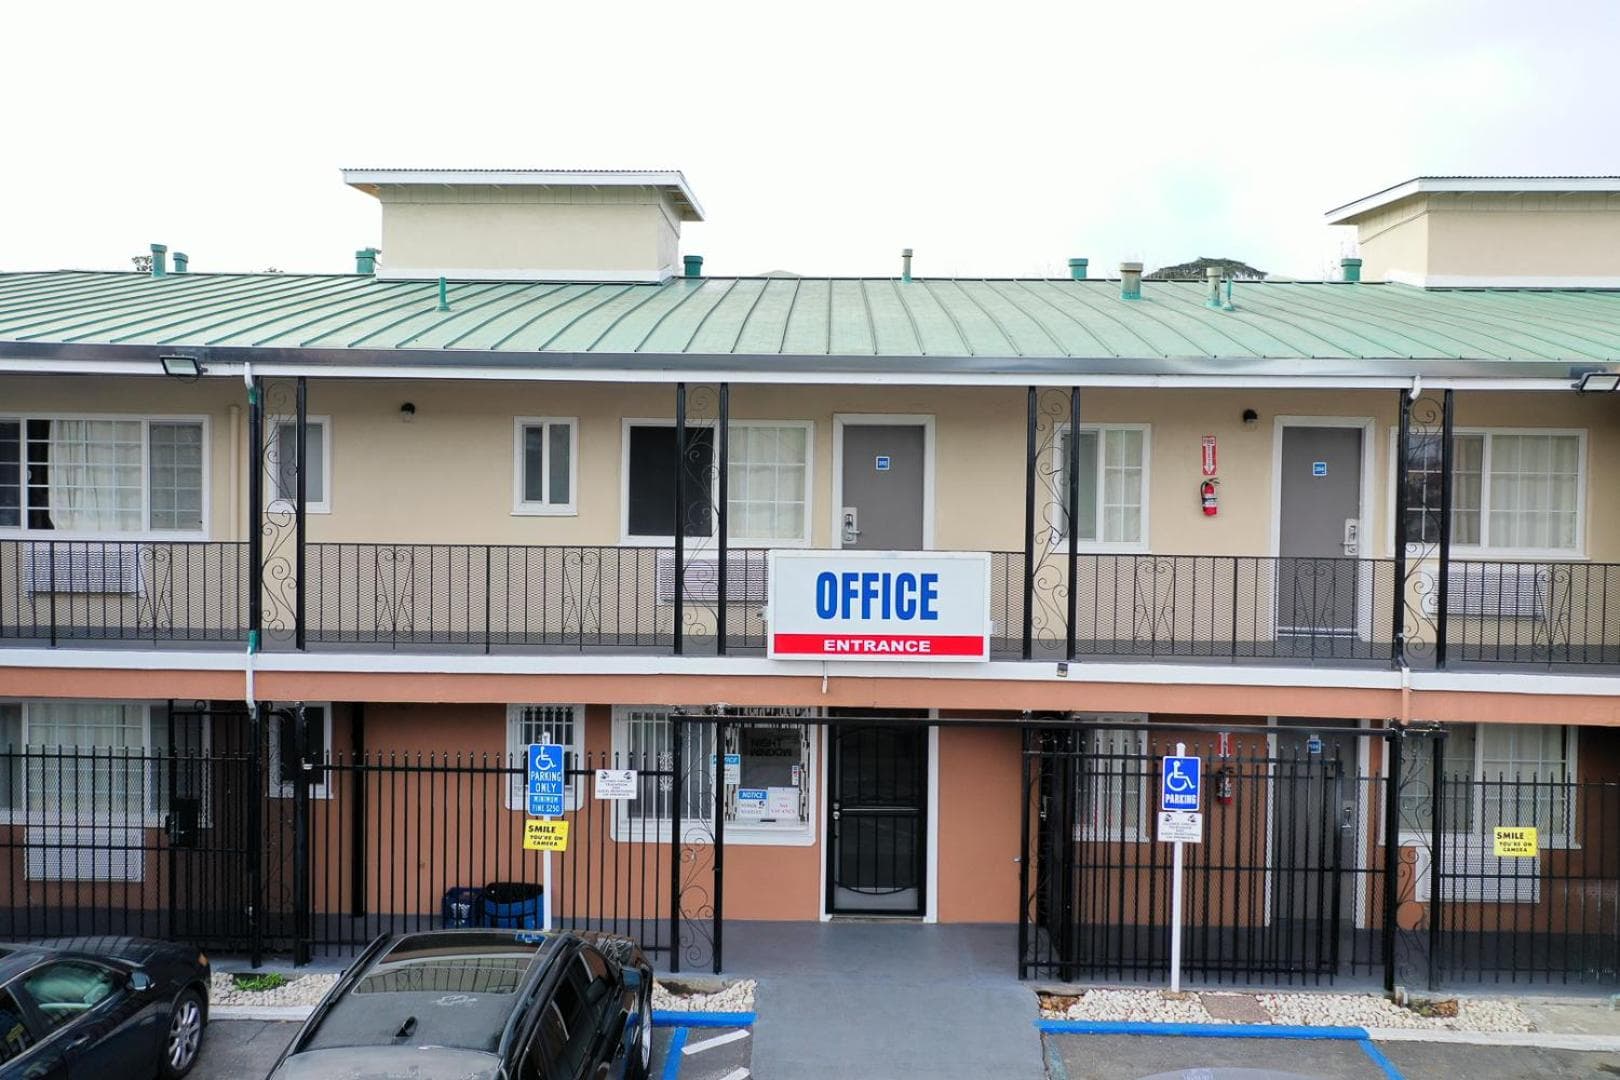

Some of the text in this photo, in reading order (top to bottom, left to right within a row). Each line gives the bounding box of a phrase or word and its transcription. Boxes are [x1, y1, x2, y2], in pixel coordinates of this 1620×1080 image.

[816, 571, 938, 620] OFFICE
[823, 639, 931, 653] ENTRANCE
[531, 771, 561, 781] PARKING
[536, 783, 557, 793] ONLY
[742, 791, 763, 799] NOTICE
[1165, 793, 1197, 804] PARKING
[528, 824, 557, 833] SMILE
[1496, 831, 1524, 839] SMILE
